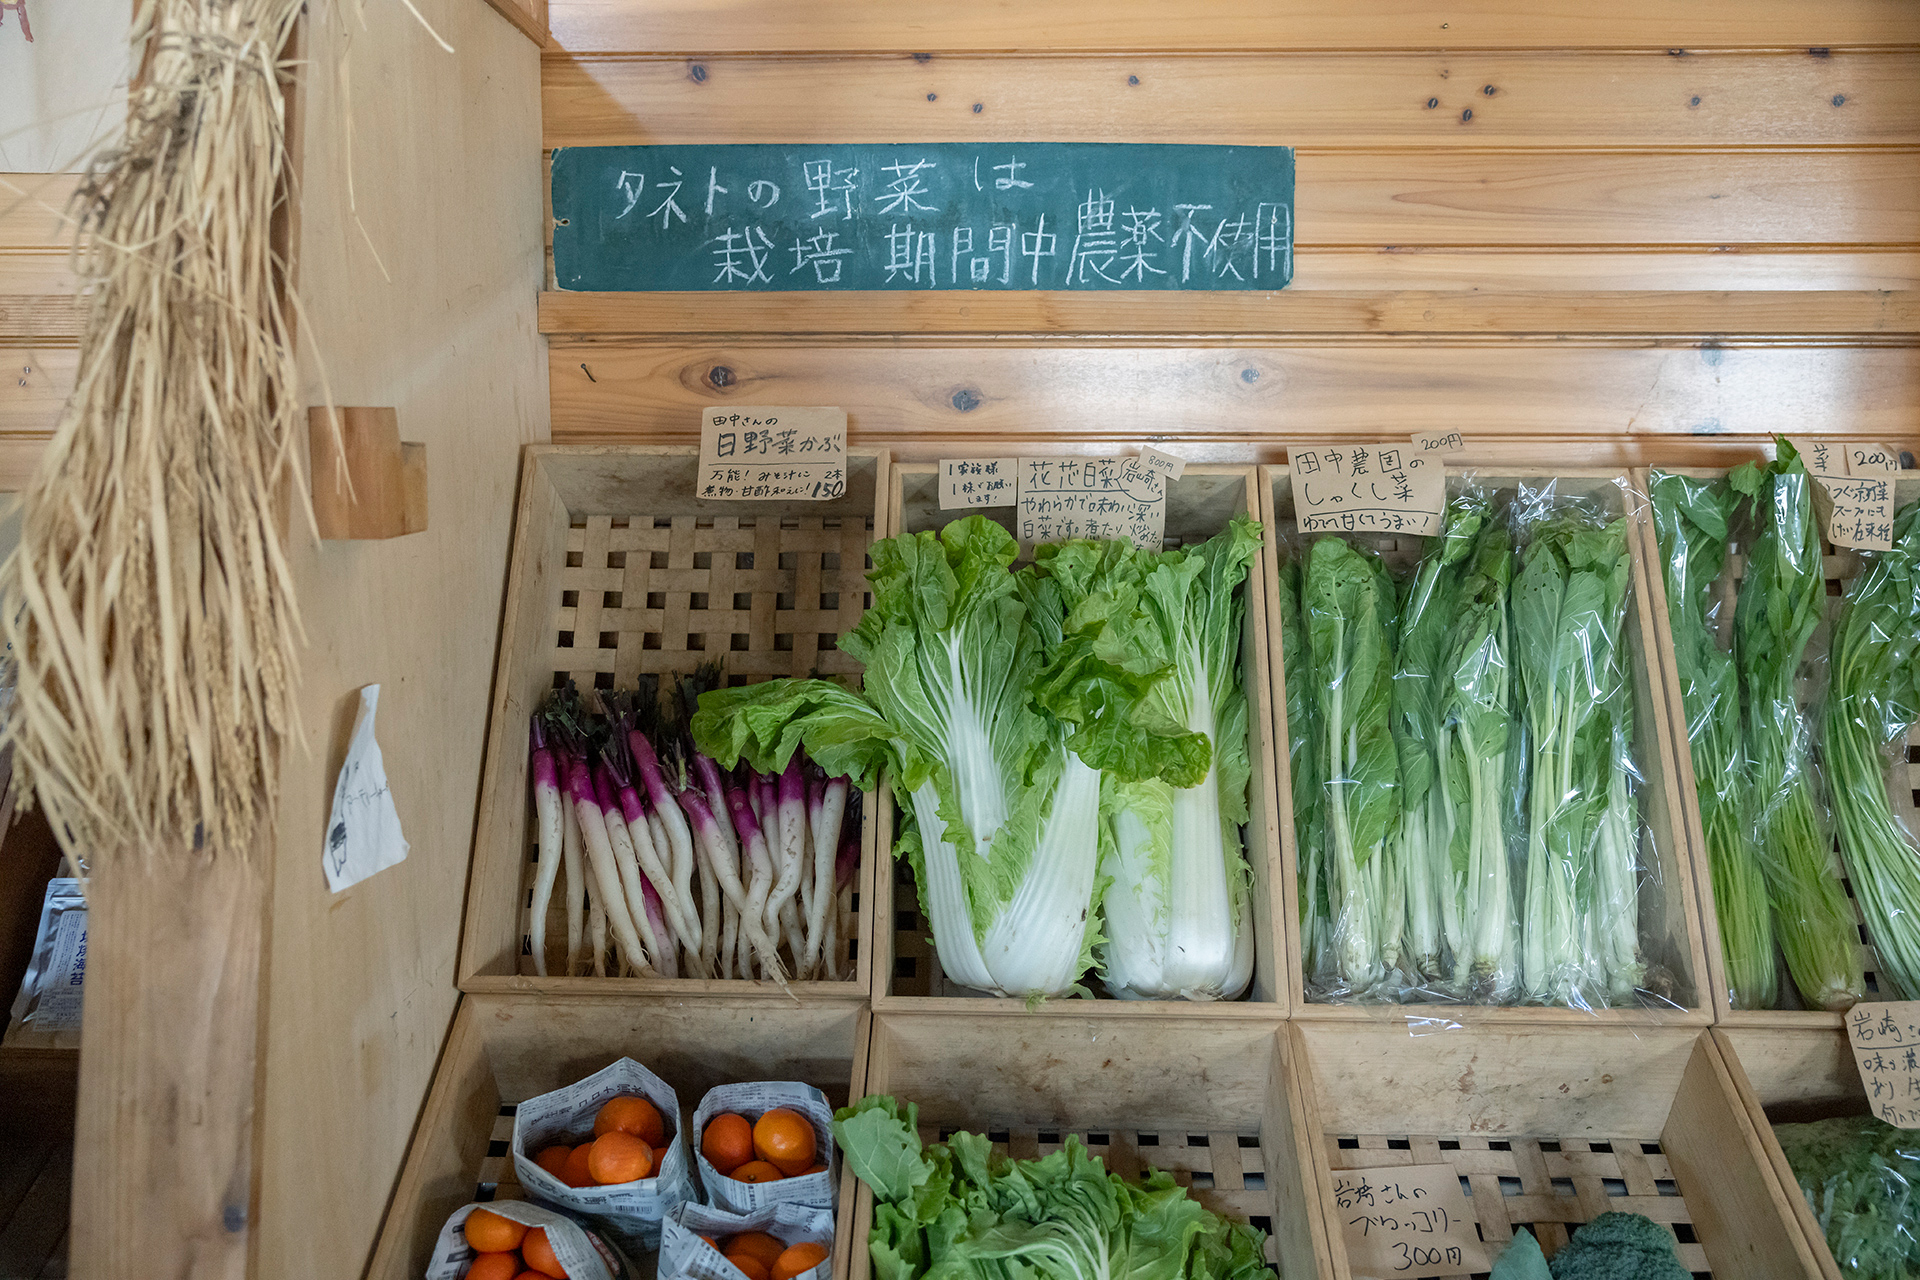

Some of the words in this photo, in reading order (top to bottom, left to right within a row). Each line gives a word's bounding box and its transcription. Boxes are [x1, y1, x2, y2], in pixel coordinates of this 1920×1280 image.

[711, 187, 1292, 286] 栽培期間中農薬不使用
[712, 413, 779, 427] 田中さんの
[717, 429, 842, 458] 日野菜かぶ
[1421, 433, 1462, 450] 200円
[823, 469, 844, 480] 2本
[1030, 459, 1116, 489] 花芯白菜
[1148, 455, 1174, 472] 800円
[1295, 447, 1425, 476] 田中農園の
[1854, 451, 1898, 471] 200円
[811, 480, 844, 498] 150
[1305, 472, 1414, 505] しゃくし菜
[1021, 493, 1160, 523] やわらかで味わい深い
[1852, 1009, 1920, 1043] 岩崎さ
[1334, 1177, 1427, 1209] 岩崎さんの
[1349, 1207, 1461, 1237] ブロッコリー
[1392, 1242, 1461, 1271] 300円
